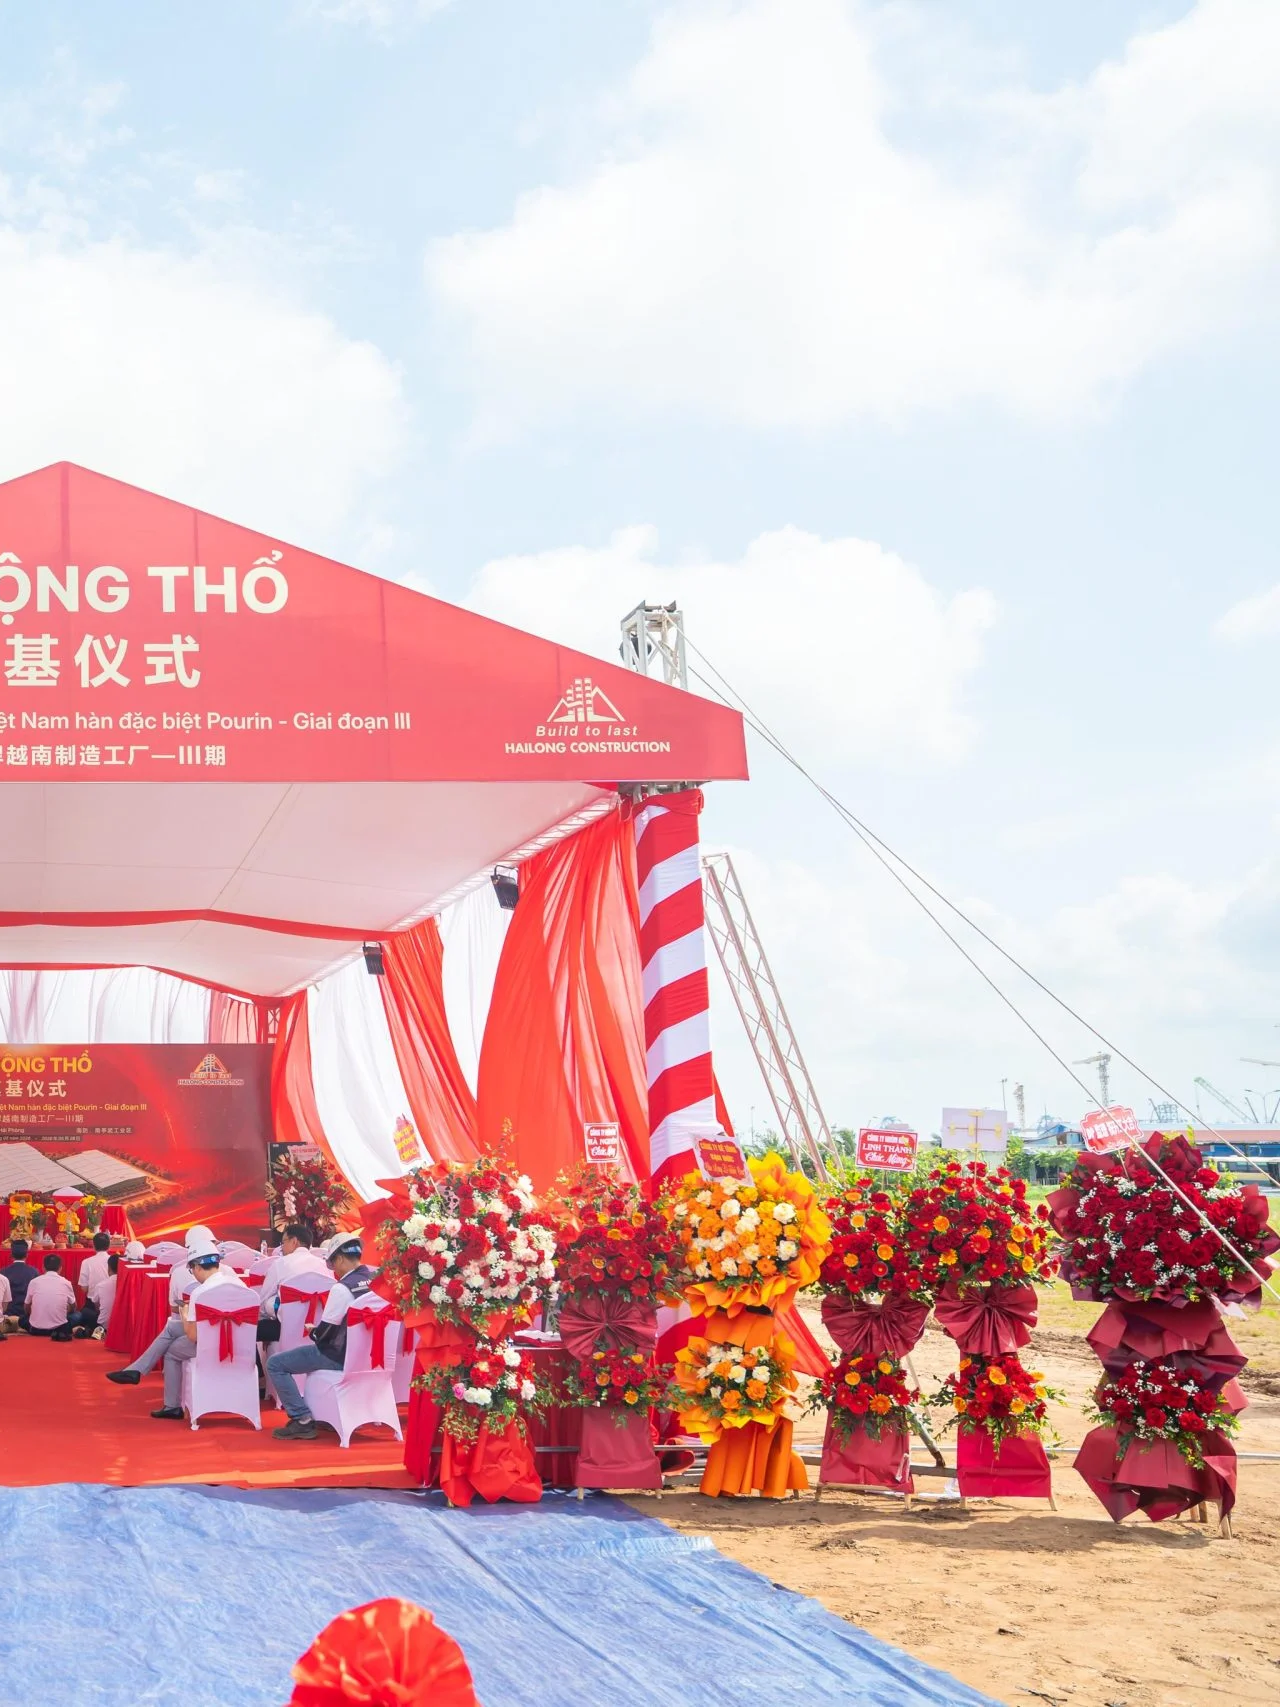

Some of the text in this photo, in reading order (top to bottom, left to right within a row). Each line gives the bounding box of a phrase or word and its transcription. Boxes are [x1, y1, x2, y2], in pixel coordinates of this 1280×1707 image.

[147, 550, 289, 614] THỔ
[21, 712, 69, 730] Nam
[75, 711, 114, 730] hàn
[119, 711, 157, 734] đặc
[162, 711, 202, 734] biệt
[207, 712, 273, 730] Pourin
[293, 712, 333, 730] Giai
[337, 711, 389, 734] đoạn
[535, 725, 639, 737] Build to last
[504, 741, 671, 754] HAILONG CONSTRUCTION
[50, 1049, 93, 1073] THỔ
[27, 1103, 41, 1111] hàn
[42, 1103, 56, 1112] đặc
[58, 1103, 72, 1112] biệt
[120, 1103, 139, 1112] đoạn
[862, 1143, 881, 1152] LINH
